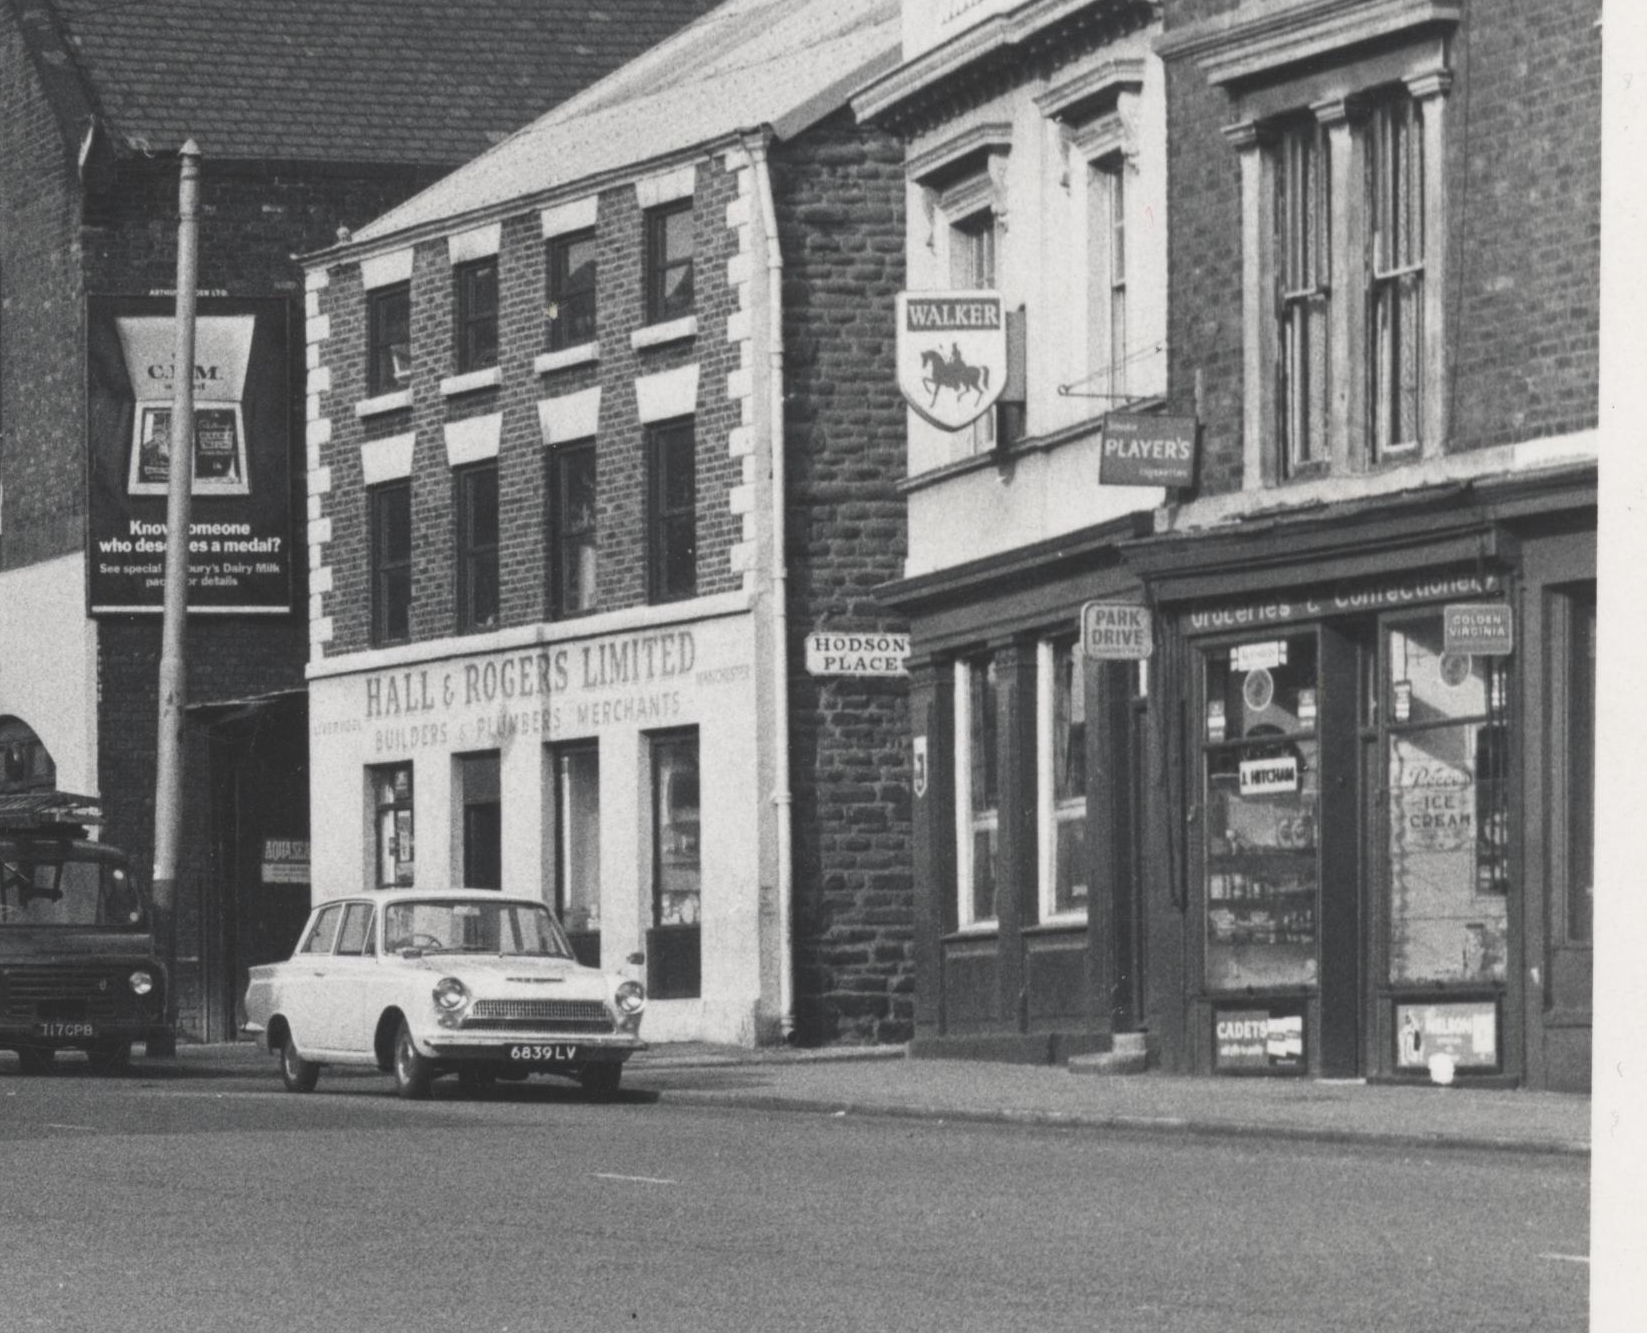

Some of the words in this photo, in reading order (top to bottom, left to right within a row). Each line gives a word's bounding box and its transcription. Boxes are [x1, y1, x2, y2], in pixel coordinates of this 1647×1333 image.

[909, 303, 1000, 326] WALKER
[1105, 436, 1191, 460] PLAYER'S
[189, 523, 251, 536] omeone
[100, 537, 133, 553] who
[210, 541, 221, 553] a
[223, 537, 282, 553] medal?
[100, 563, 122, 574] See
[123, 563, 162, 576] special
[223, 563, 254, 576] Dairy
[256, 563, 282, 574] Milk
[202, 575, 239, 587] details
[1095, 609, 1143, 628] PARK
[1453, 614, 1502, 625] GOLDEN
[1092, 628, 1145, 646] DRIVE
[1449, 626, 1506, 637] VIRGINIA
[815, 637, 905, 652] HODSON
[824, 656, 899, 671] PLACE
[365, 670, 435, 718] HALL
[443, 673, 456, 707] &
[464, 650, 569, 706] ROGERS
[582, 631, 696, 689] LIMITED
[375, 722, 448, 752] BUILDERS
[477, 707, 563, 741] PLUMBERS
[577, 690, 681, 725] MERCHANTS
[1425, 795, 1457, 810] ICE
[1409, 813, 1471, 829] CREAM
[1216, 1020, 1268, 1040] CADETS
[511, 1046, 553, 1060] 6839
[556, 1046, 577, 1060] LV
